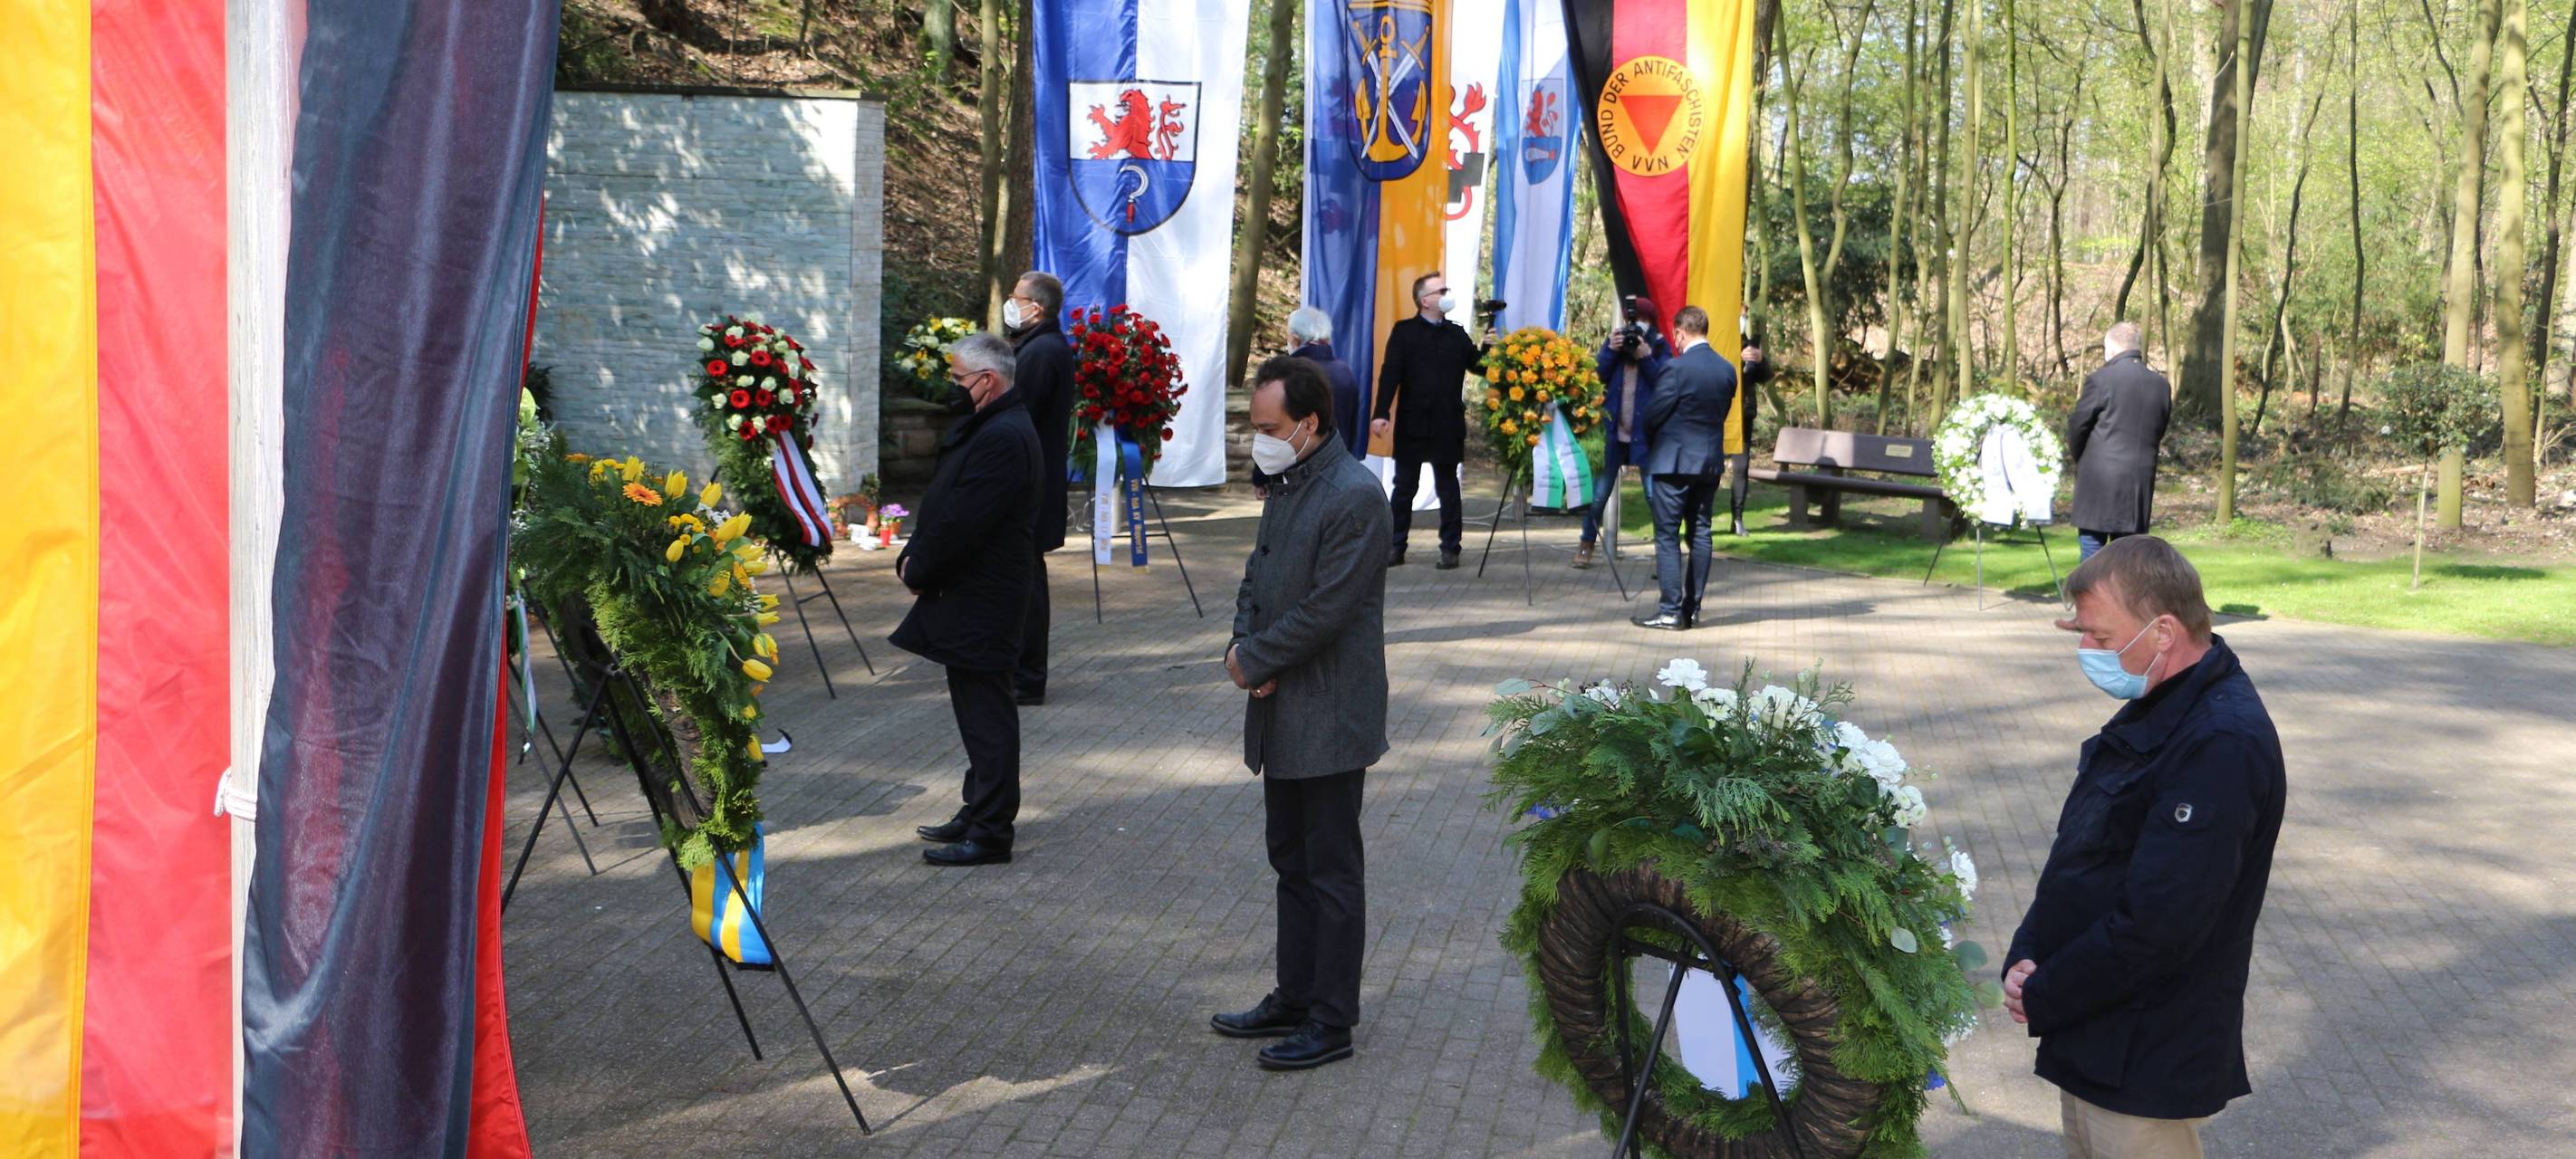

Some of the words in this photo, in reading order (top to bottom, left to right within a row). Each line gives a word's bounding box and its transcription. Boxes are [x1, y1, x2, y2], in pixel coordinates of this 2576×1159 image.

[1604, 72, 1629, 104] DER
[1634, 60, 1702, 158] ANTIFASCHISTEN
[1601, 110, 1625, 158] BUND
[1631, 154, 1669, 172] VVN
